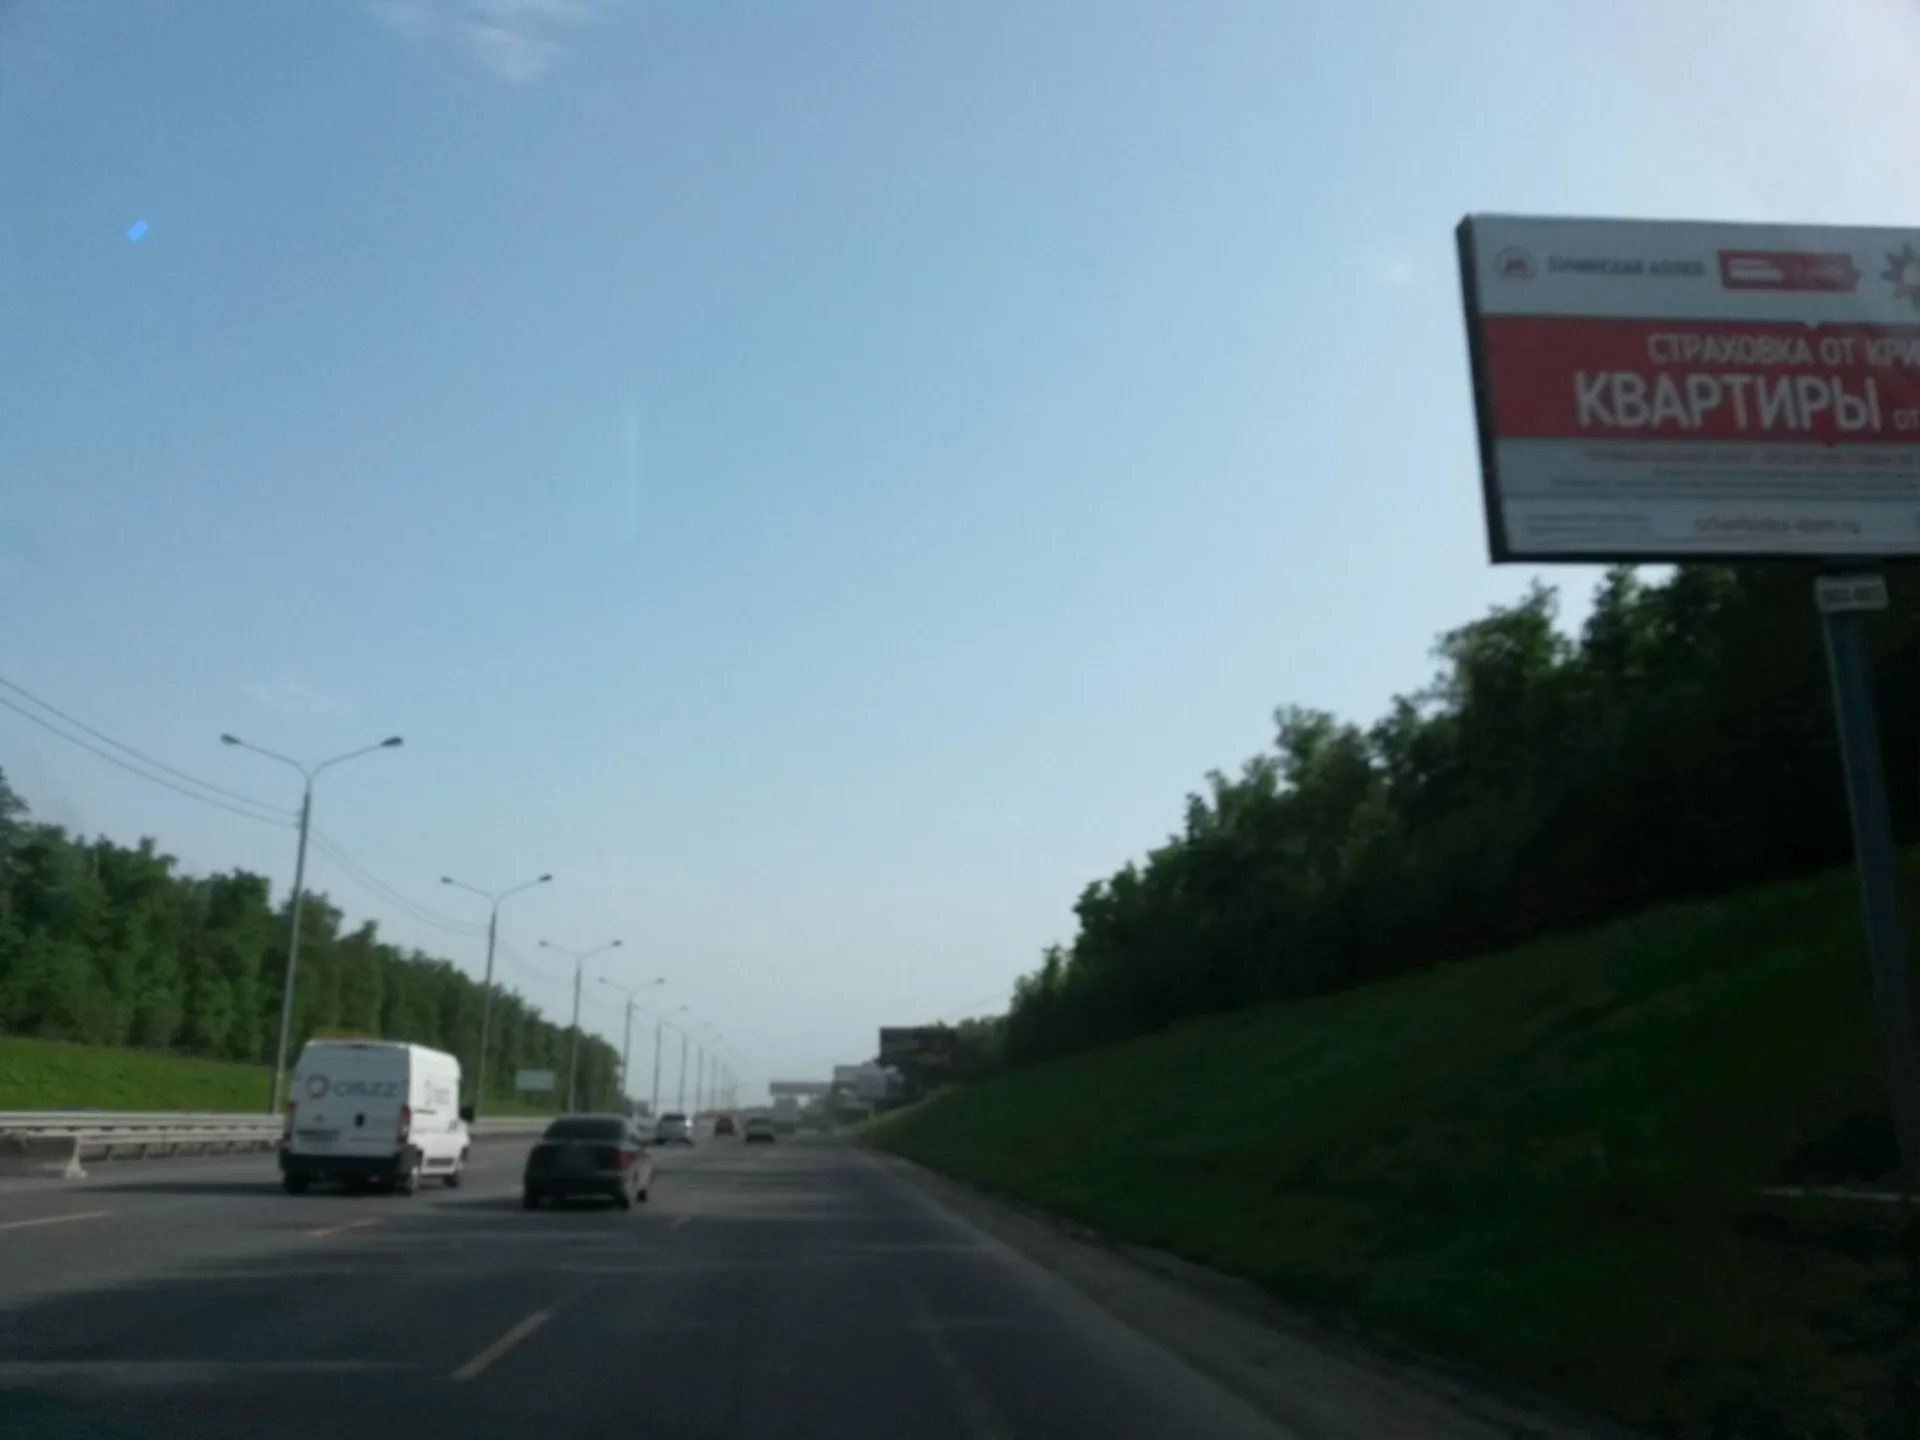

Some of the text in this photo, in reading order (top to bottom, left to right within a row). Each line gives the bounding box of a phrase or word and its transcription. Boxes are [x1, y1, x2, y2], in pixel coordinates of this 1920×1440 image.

[1646, 332, 1814, 365] СТРАХОВКА
[1819, 337, 1855, 366] ОТ
[1574, 370, 1881, 431] КВАРТИРЫ
